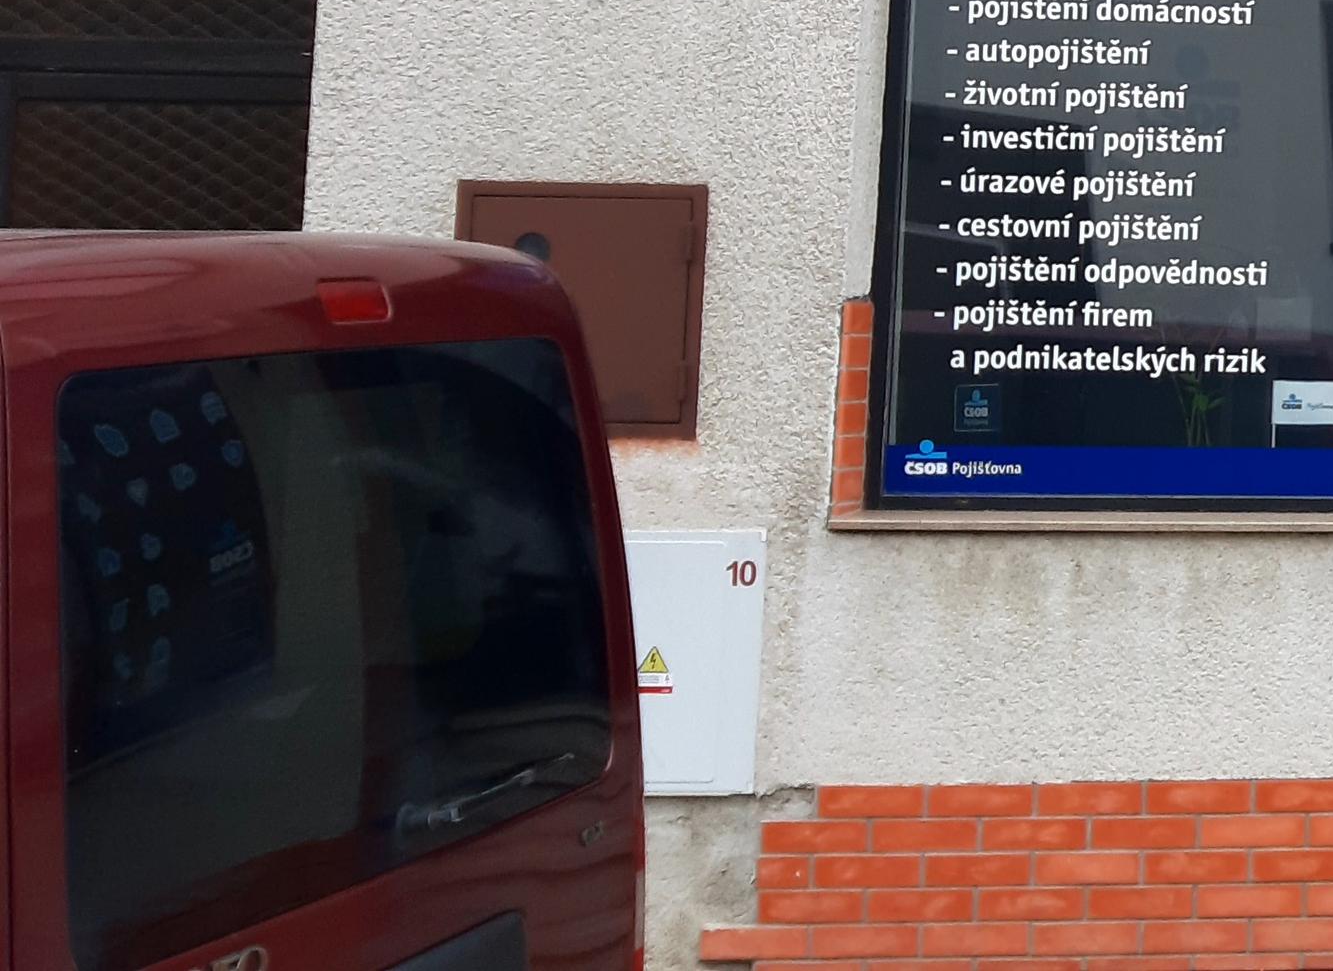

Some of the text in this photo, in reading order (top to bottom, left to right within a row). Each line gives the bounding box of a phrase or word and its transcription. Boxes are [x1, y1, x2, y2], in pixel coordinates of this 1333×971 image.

[965, 38, 1152, 71] autopojištění
[963, 79, 1060, 106] životní
[1065, 82, 1189, 115] pojištění
[960, 123, 1098, 151] investiční
[1103, 126, 1226, 159] pojištění
[960, 166, 1066, 195] úrazové
[1073, 170, 1197, 203] pojištění
[957, 212, 1074, 238] cestovní
[1078, 214, 1203, 247] pojištění
[955, 255, 1080, 288] pojištění
[1084, 257, 1268, 290] odpovědnosti
[953, 299, 1078, 332] pojištění
[1081, 301, 1153, 328] firem
[950, 344, 1266, 379] a podnikatelských rizik
[904, 460, 1022, 478] ČSOB Pojišťovna
[726, 560, 758, 587] 10
